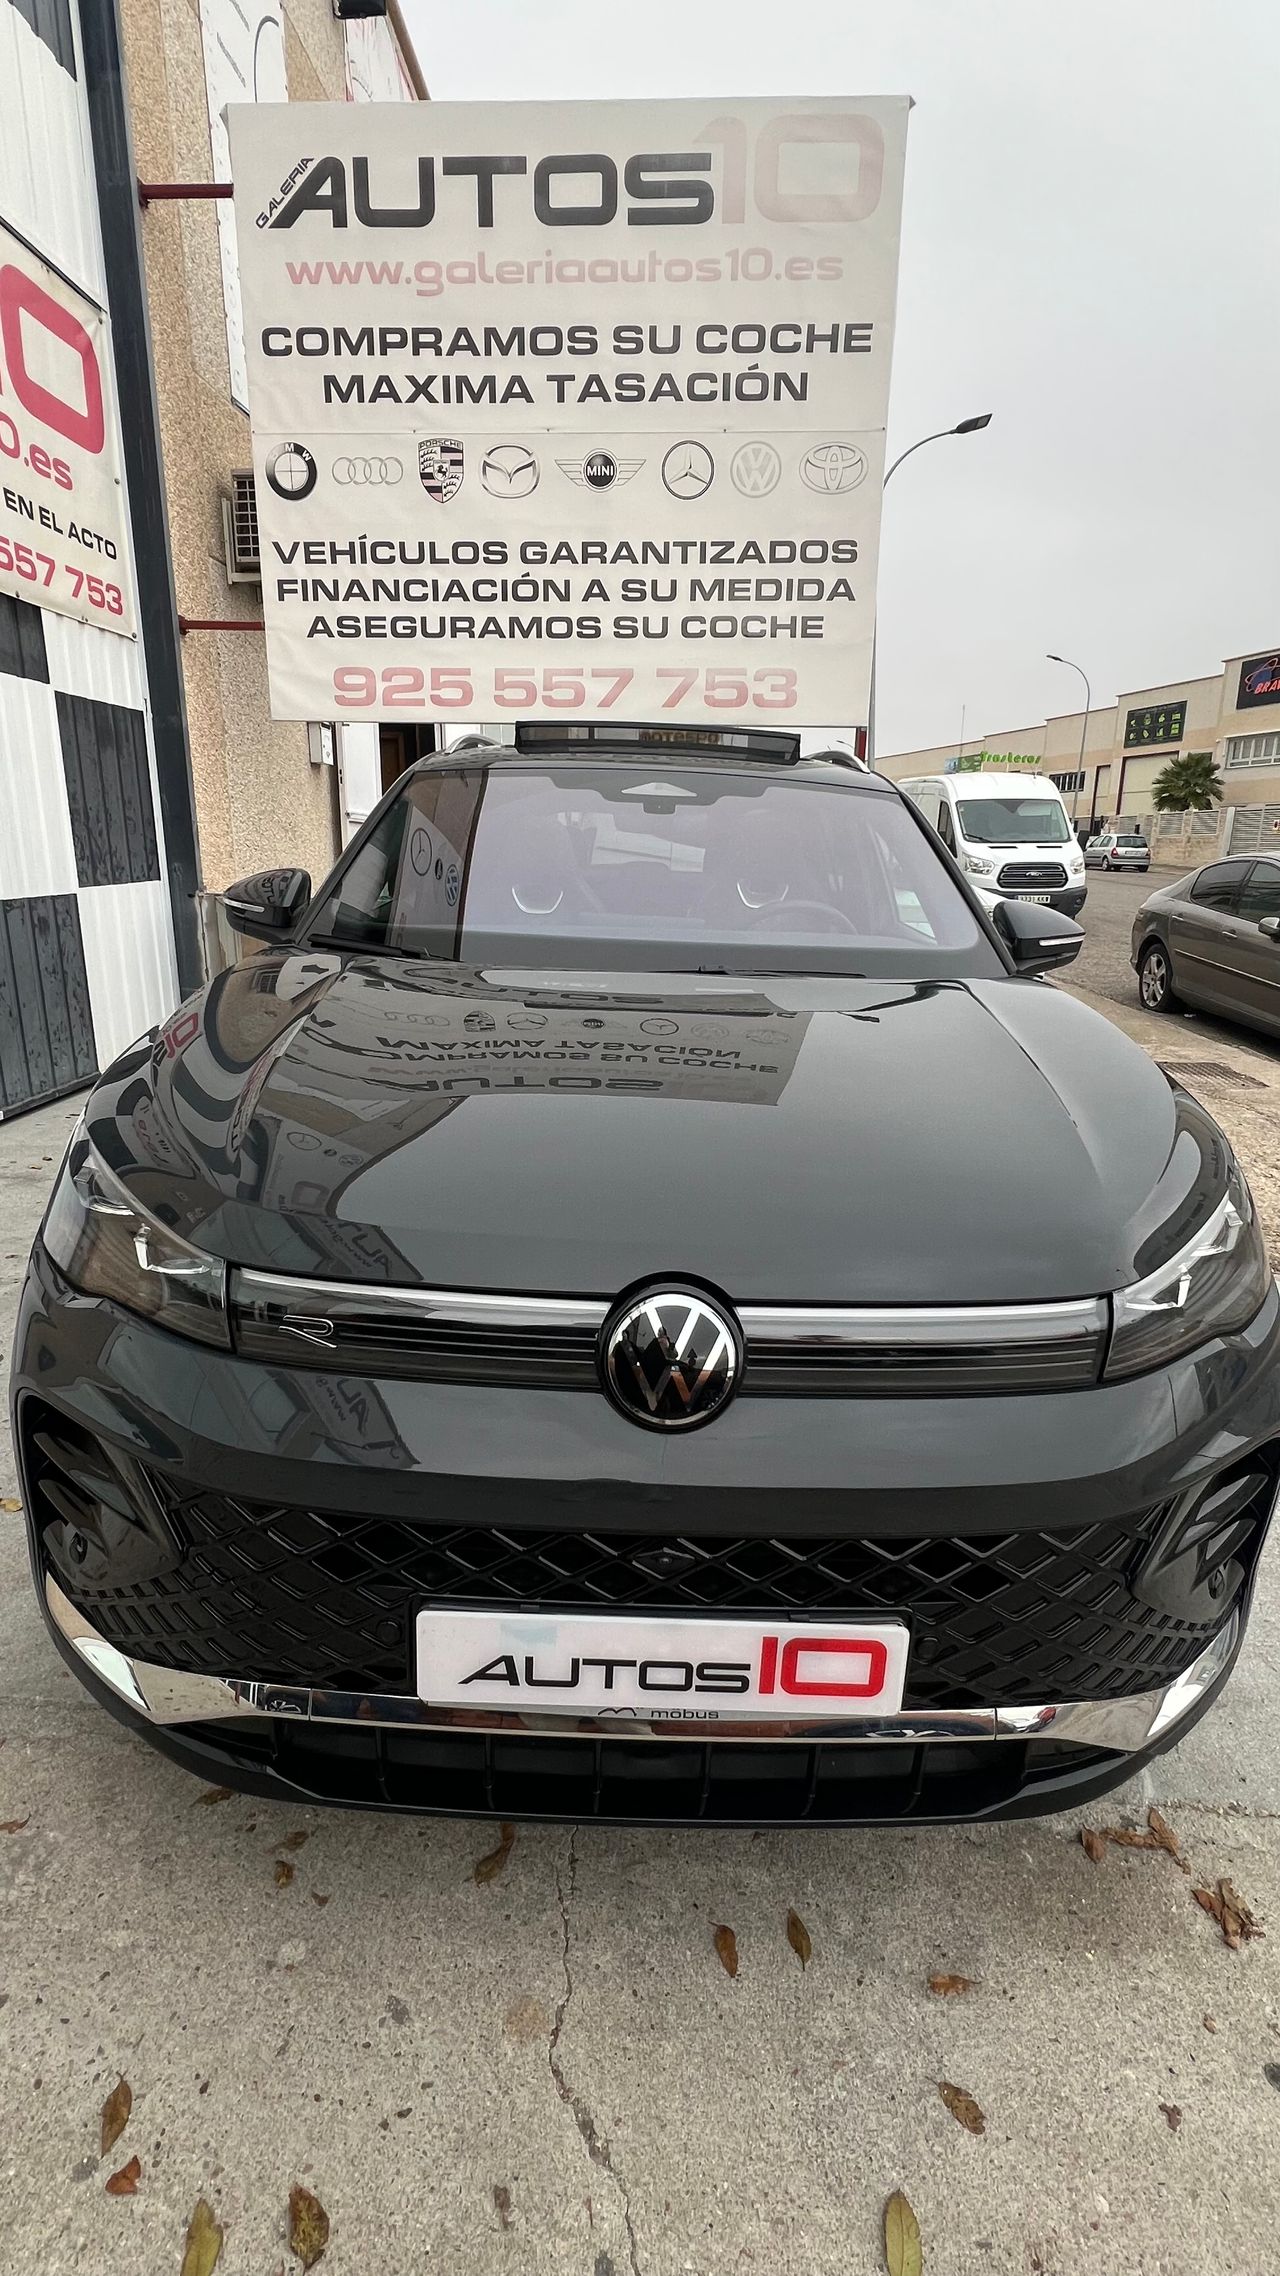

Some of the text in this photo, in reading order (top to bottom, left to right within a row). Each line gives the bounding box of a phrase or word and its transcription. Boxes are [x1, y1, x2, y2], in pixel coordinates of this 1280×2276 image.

[267, 113, 886, 229] AUTOS10
[255, 157, 315, 229] GALERIA
[285, 246, 844, 298] www.galeriaautos10.es
[0, 264, 105, 455] 0
[261, 323, 875, 357] COMPRAMOS SU COCHE
[323, 362, 809, 404] MAXIMA TASACIÓN
[419, 439, 463, 449] PORSCHE
[586, 464, 615, 477] MINI
[2, 486, 117, 560] EN EL ACTO
[271, 533, 859, 565] VEHÍCULOS GARANTIZADOS
[64, 564, 122, 617] 753
[276, 571, 856, 603] FINANCIACIÓN A SU MEDIDA
[306, 615, 824, 639] ASEGURAMOS SU COCHE
[332, 664, 798, 711] 925 557 753
[1254, 679, 1280, 694] BRA
[458, 1636, 887, 1697] AUTOS10
[650, 1708, 719, 1719] möbus
